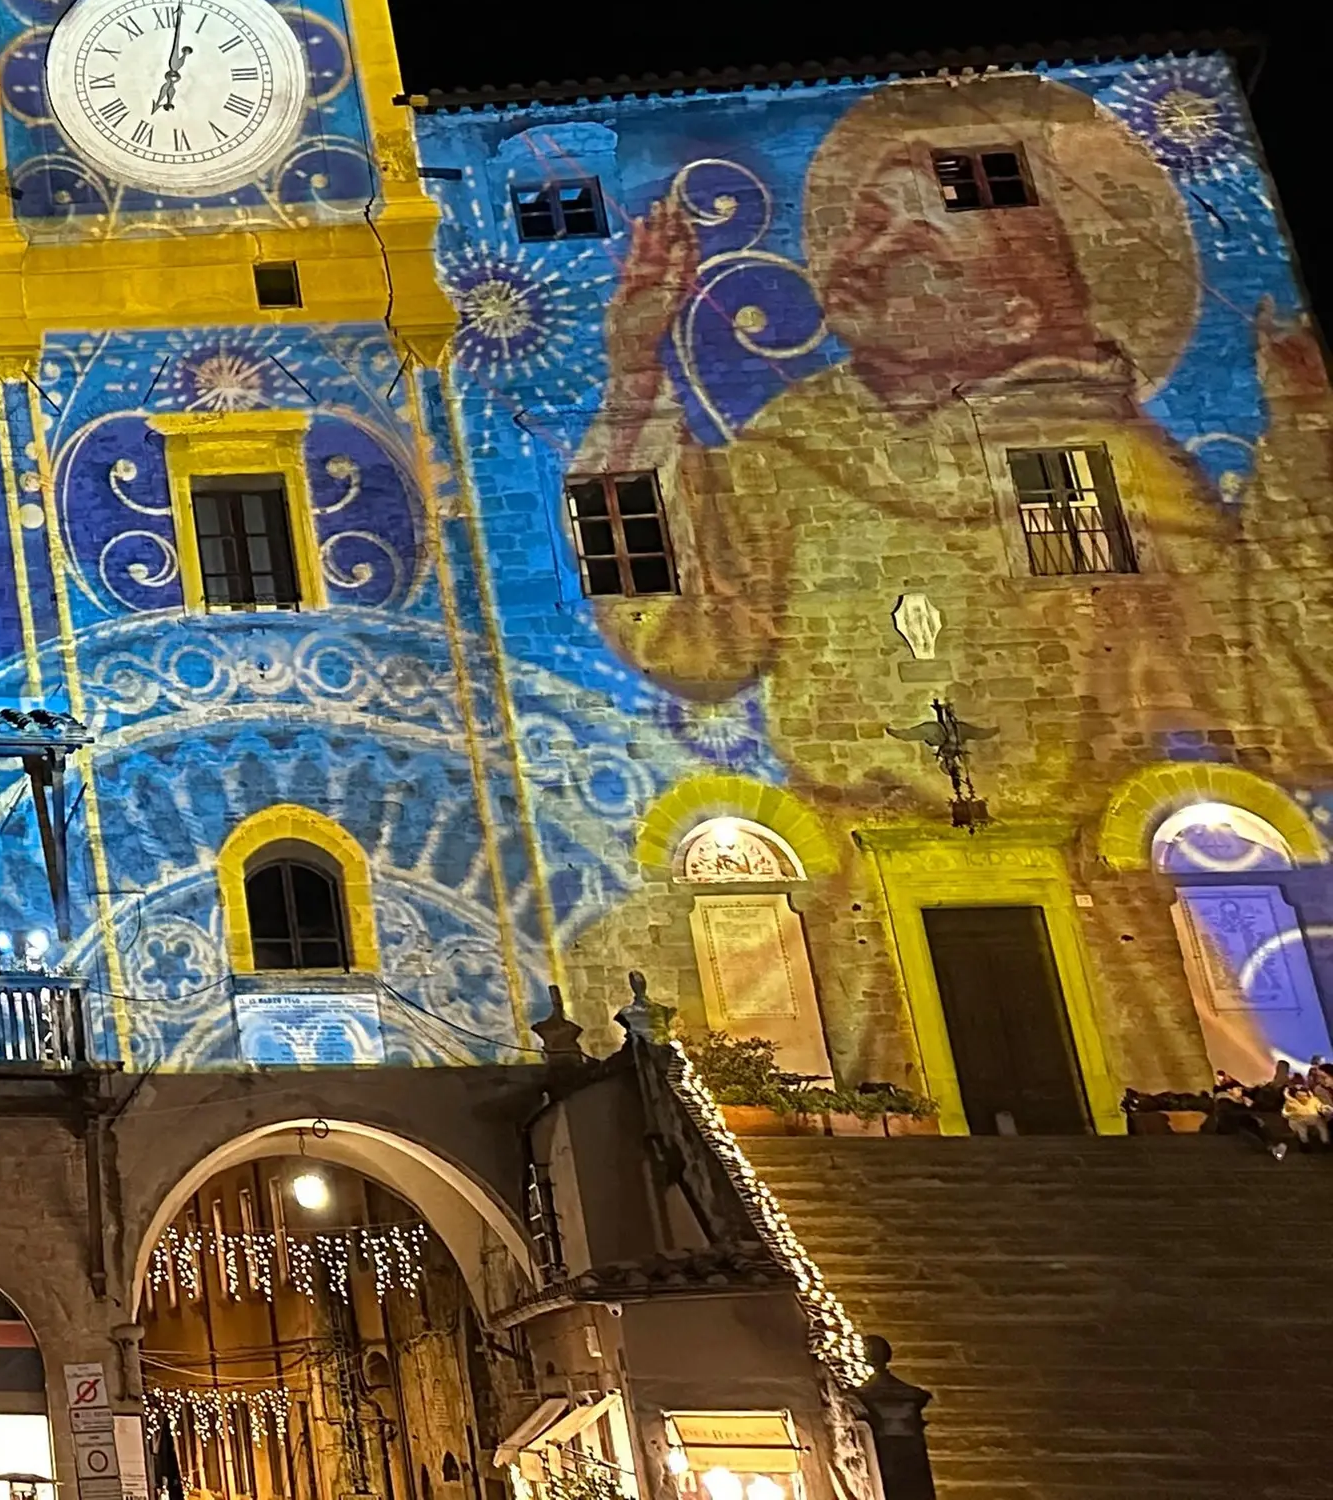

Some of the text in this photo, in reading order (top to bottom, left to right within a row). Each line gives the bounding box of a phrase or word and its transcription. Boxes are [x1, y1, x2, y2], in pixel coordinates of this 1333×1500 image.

[117, 15, 145, 42] XI
[95, 43, 121, 61] X
[219, 35, 243, 54] II
[89, 73, 115, 89] IX
[231, 67, 258, 81] III
[98, 98, 130, 129] VIII
[131, 120, 154, 147] VII
[173, 128, 191, 152] VI
[208, 121, 229, 143] V
